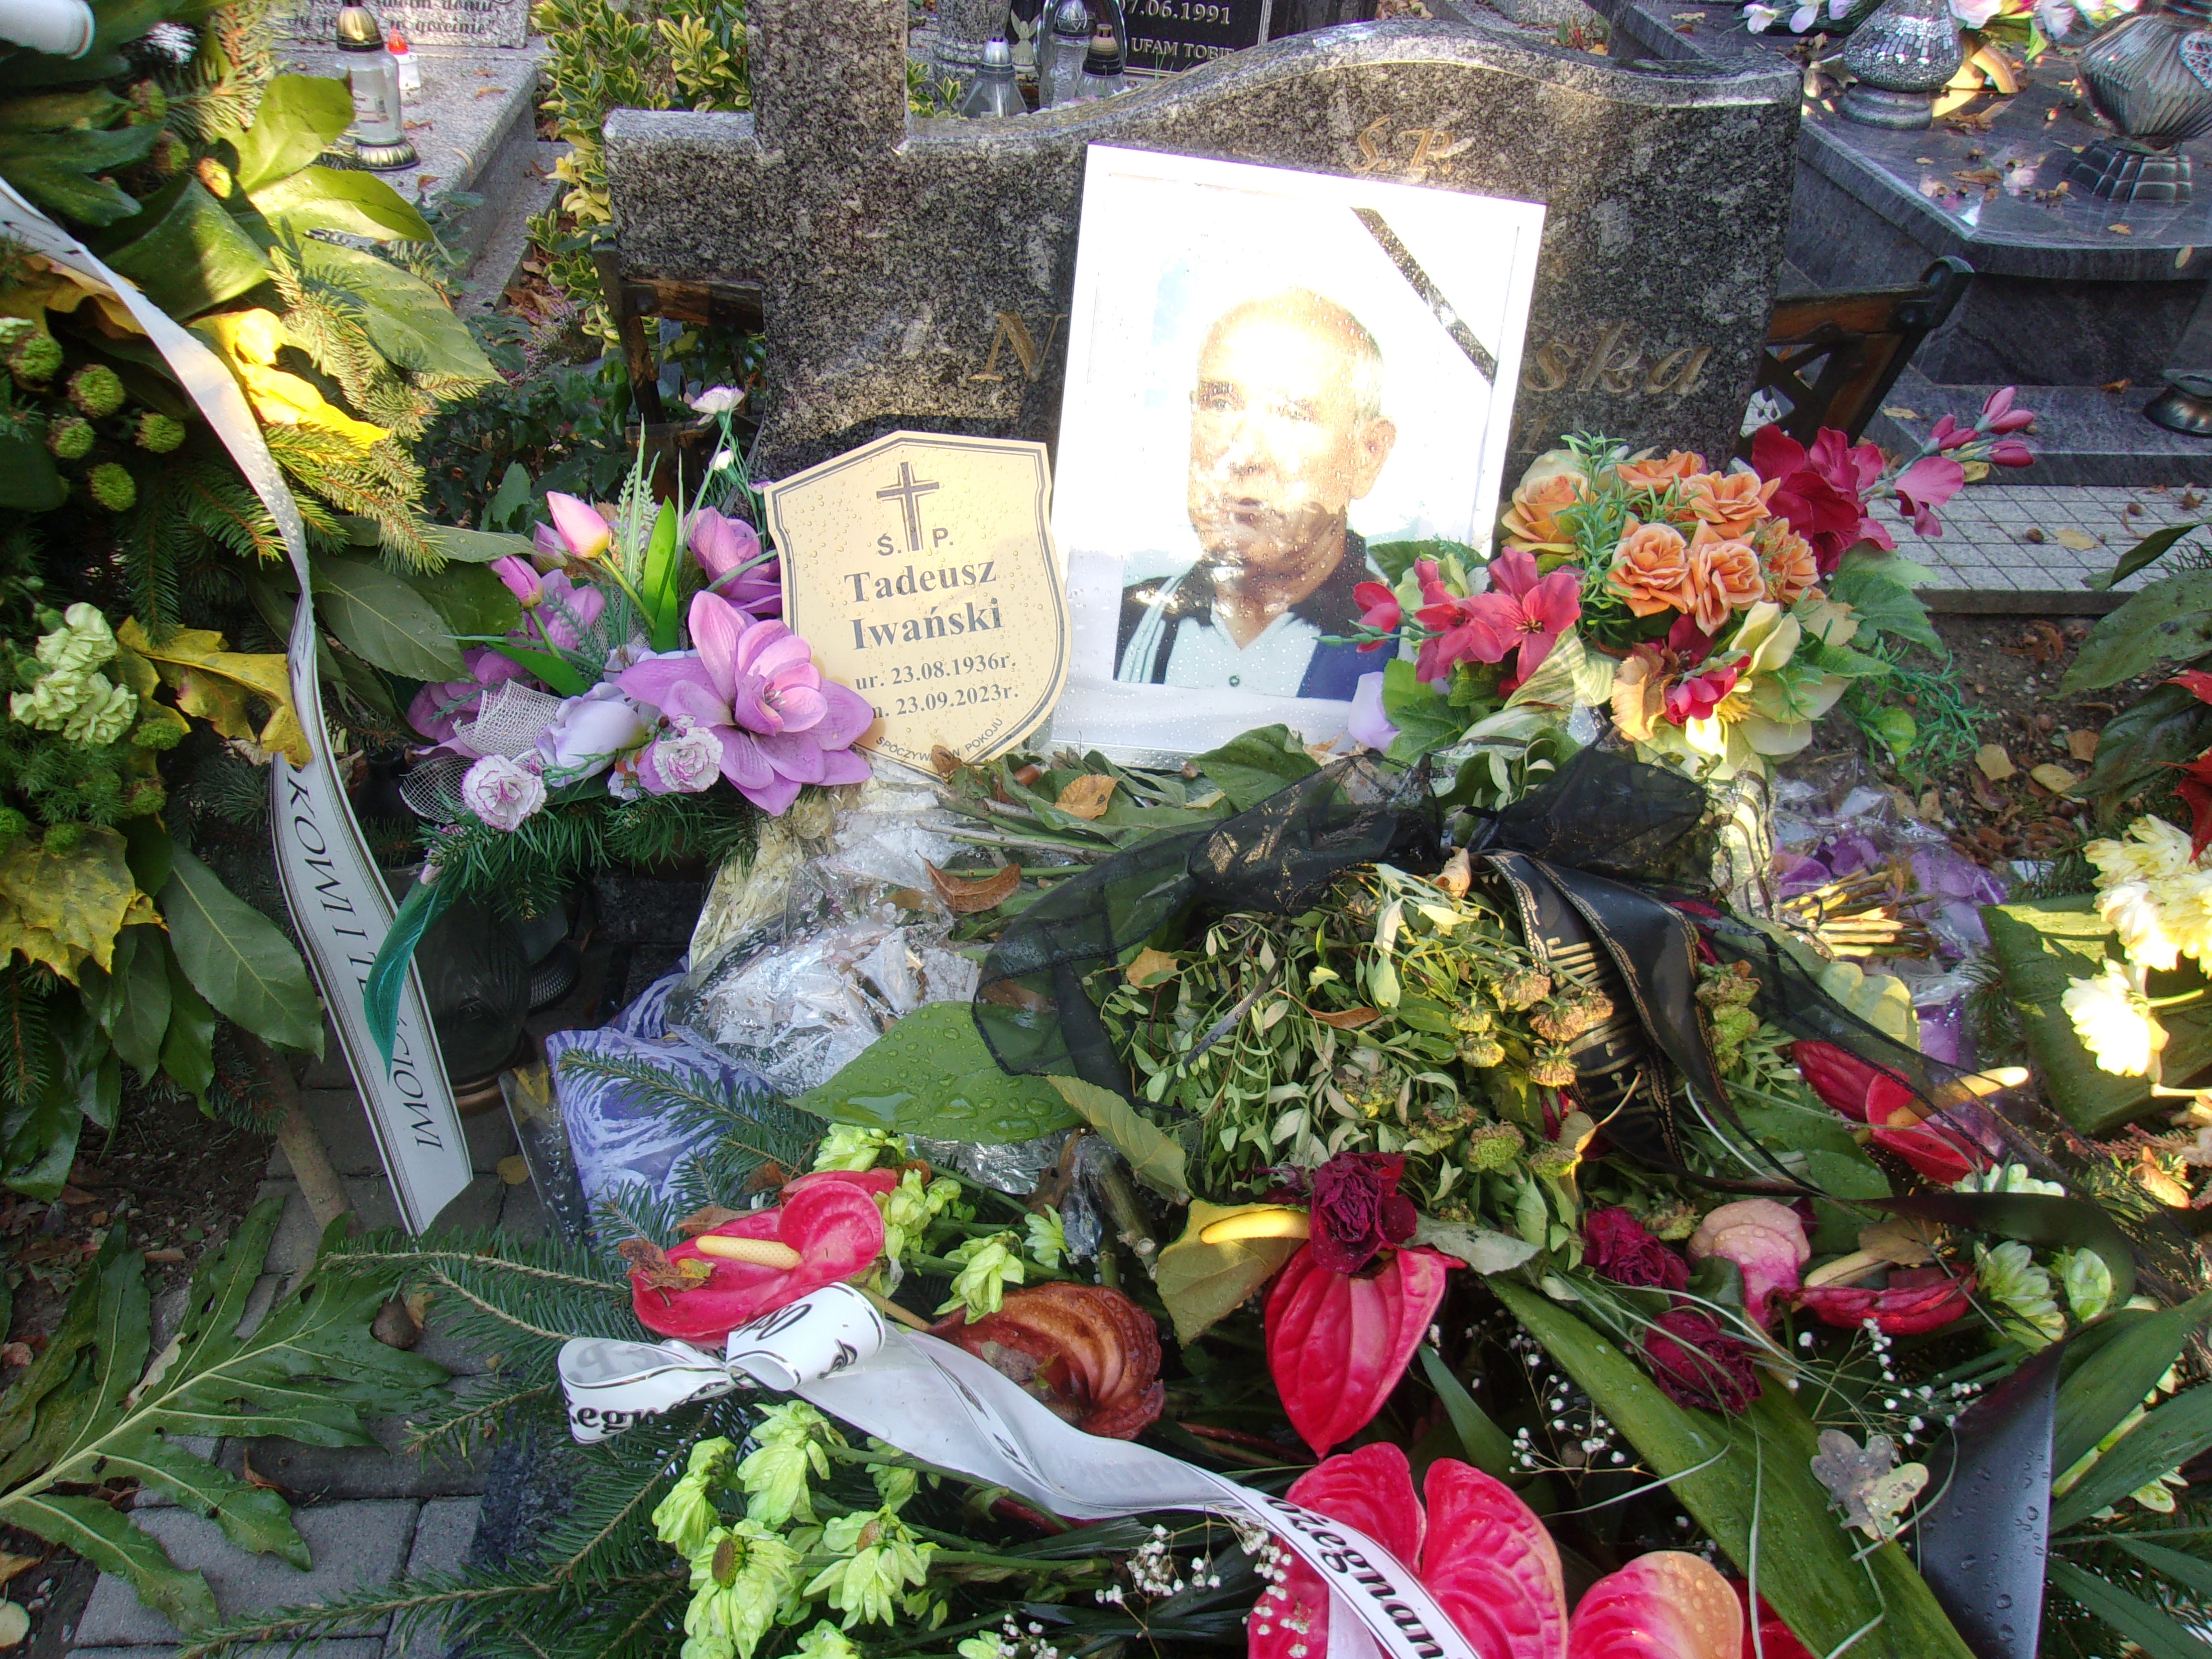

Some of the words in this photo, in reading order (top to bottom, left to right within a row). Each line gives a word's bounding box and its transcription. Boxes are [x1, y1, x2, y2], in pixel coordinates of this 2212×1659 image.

[1121, 0, 1230, 24] 7.06.1991
[1131, 37, 1178, 56] UFAM
[877, 532, 902, 556] Ś.
[932, 528, 954, 548] P.
[843, 561, 997, 603] Tadeusz
[849, 598, 1004, 650] Iwański
[855, 674, 885, 690] ur.
[890, 652, 1016, 685] 23.08.1936r.
[895, 684, 1019, 716] 23.09.2023r.
[876, 736, 932, 761] SPOCZYW
[964, 718, 1003, 752] POKOJU
[287, 765, 356, 916] KOWI
[1262, 1496, 1445, 1659] ożegnan
